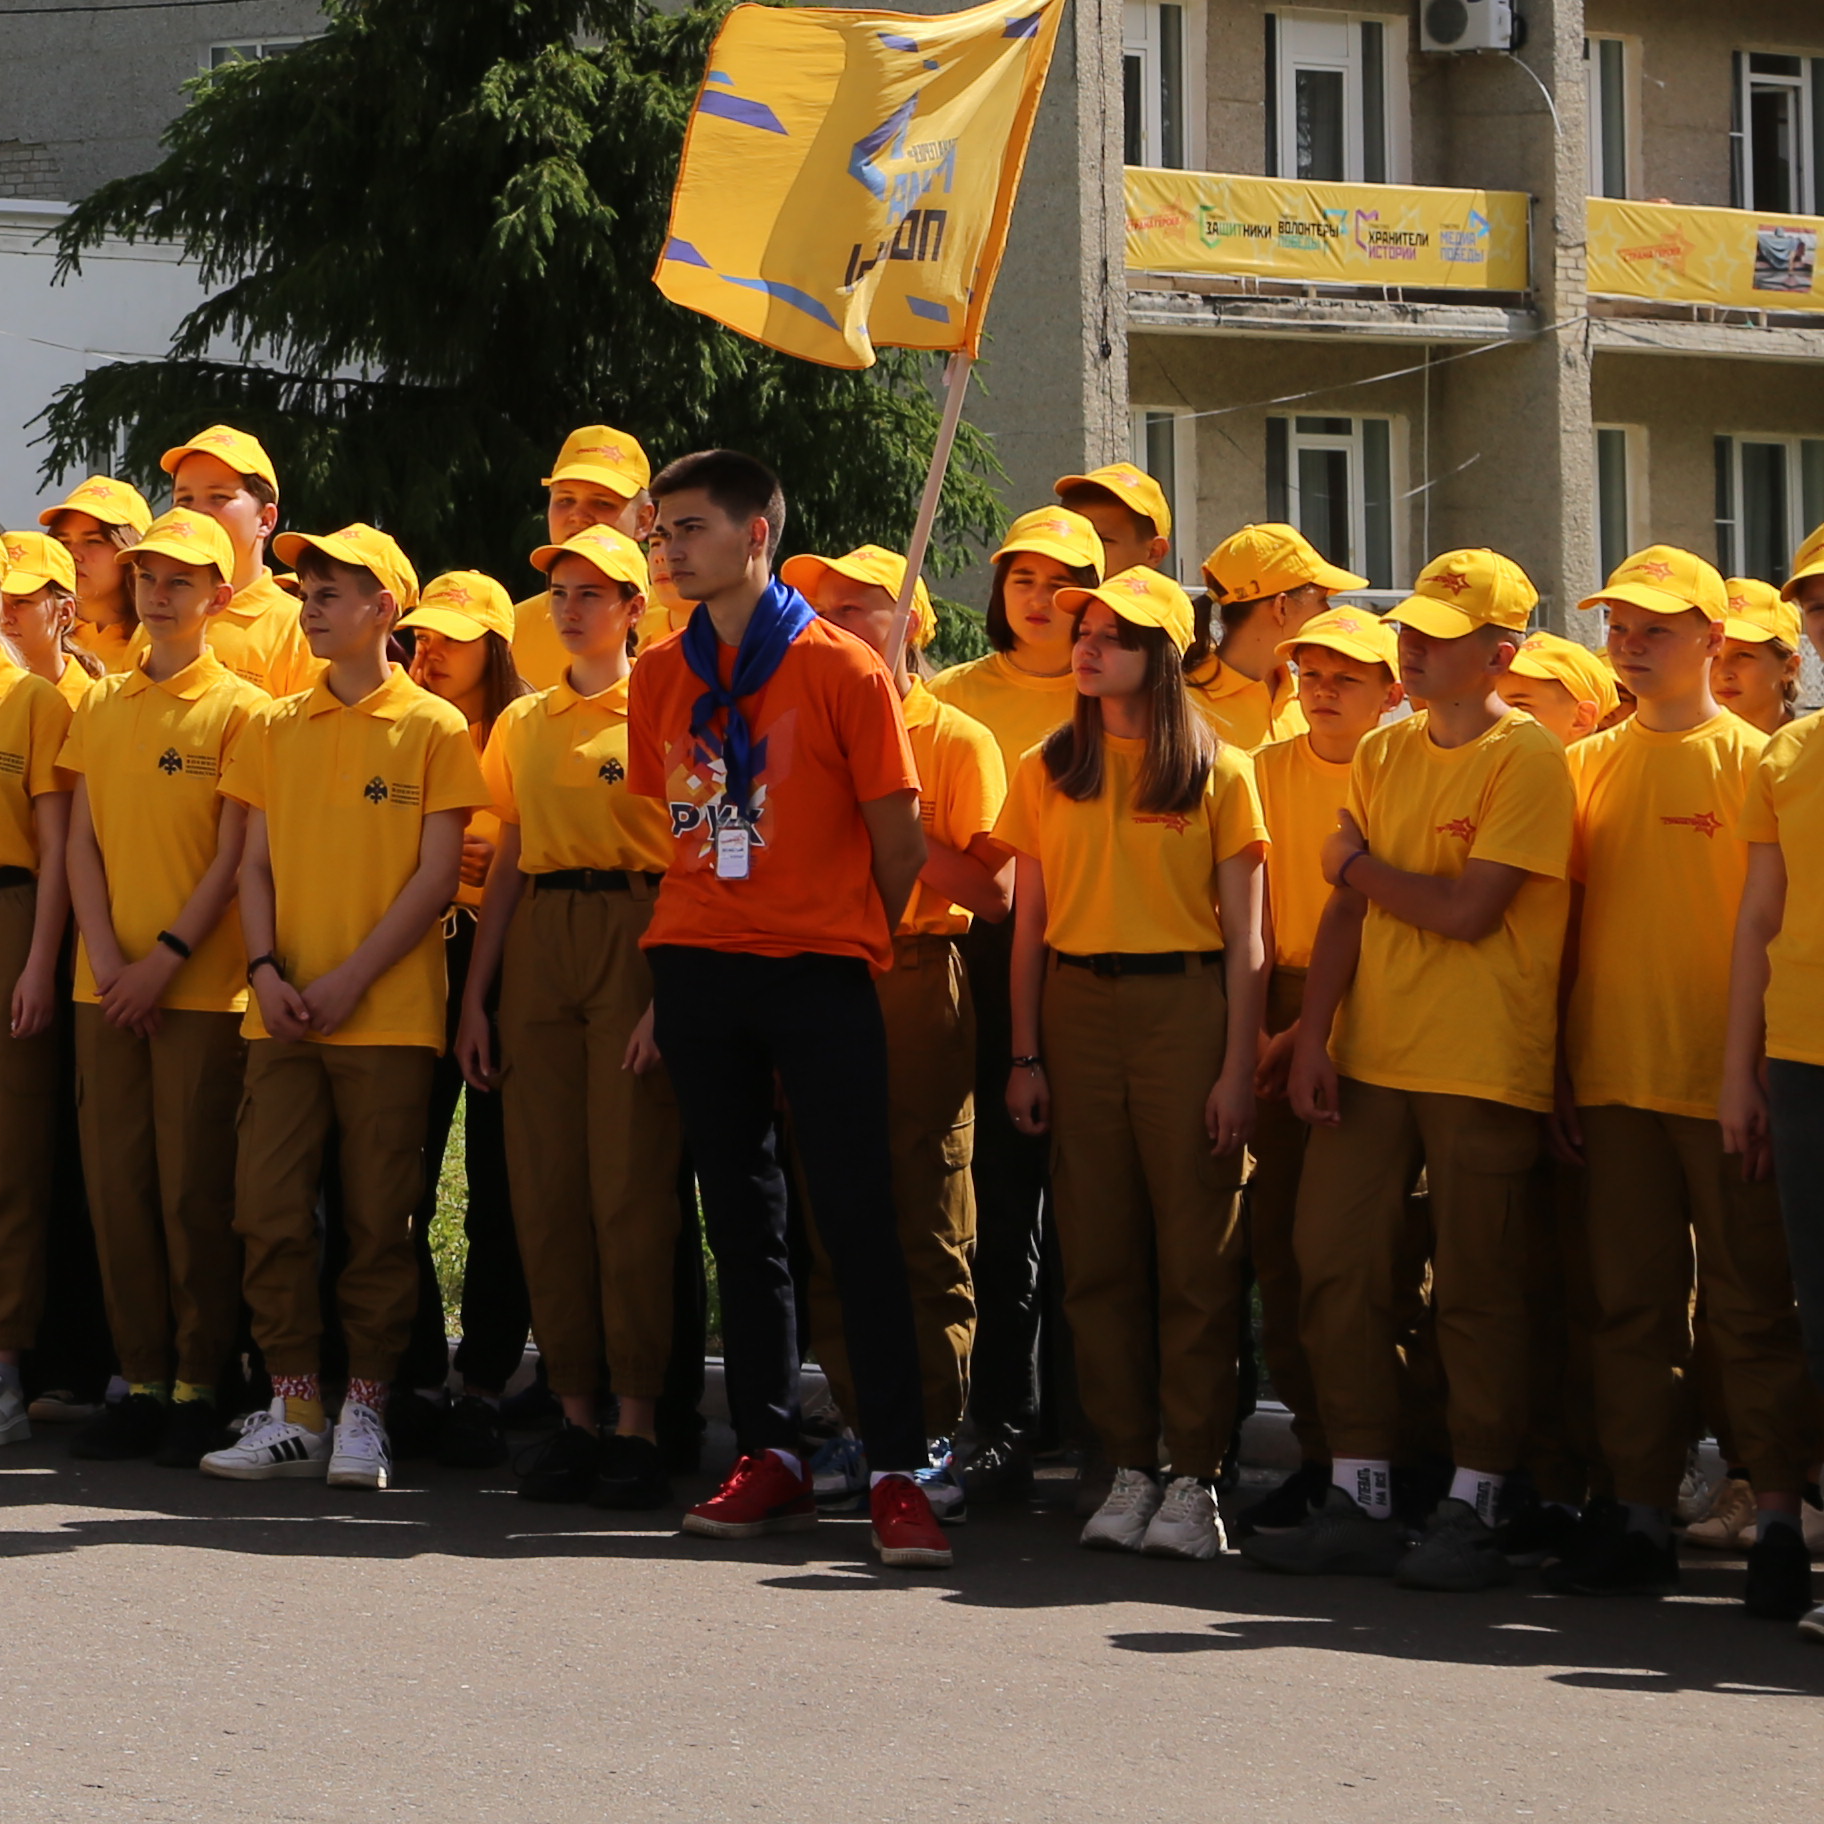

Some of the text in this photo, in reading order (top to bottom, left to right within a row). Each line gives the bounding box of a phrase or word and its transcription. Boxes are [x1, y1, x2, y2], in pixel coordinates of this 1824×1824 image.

[1206, 221, 1271, 238] ЗАЩИТНИКИ
[1368, 232, 1429, 247] ХРАНИТЕЛИ
[1440, 231, 1476, 246] МЕДИА
[1368, 246, 1416, 260] ИСТОРИИ
[1440, 247, 1484, 263] ПОБЕДЫ
